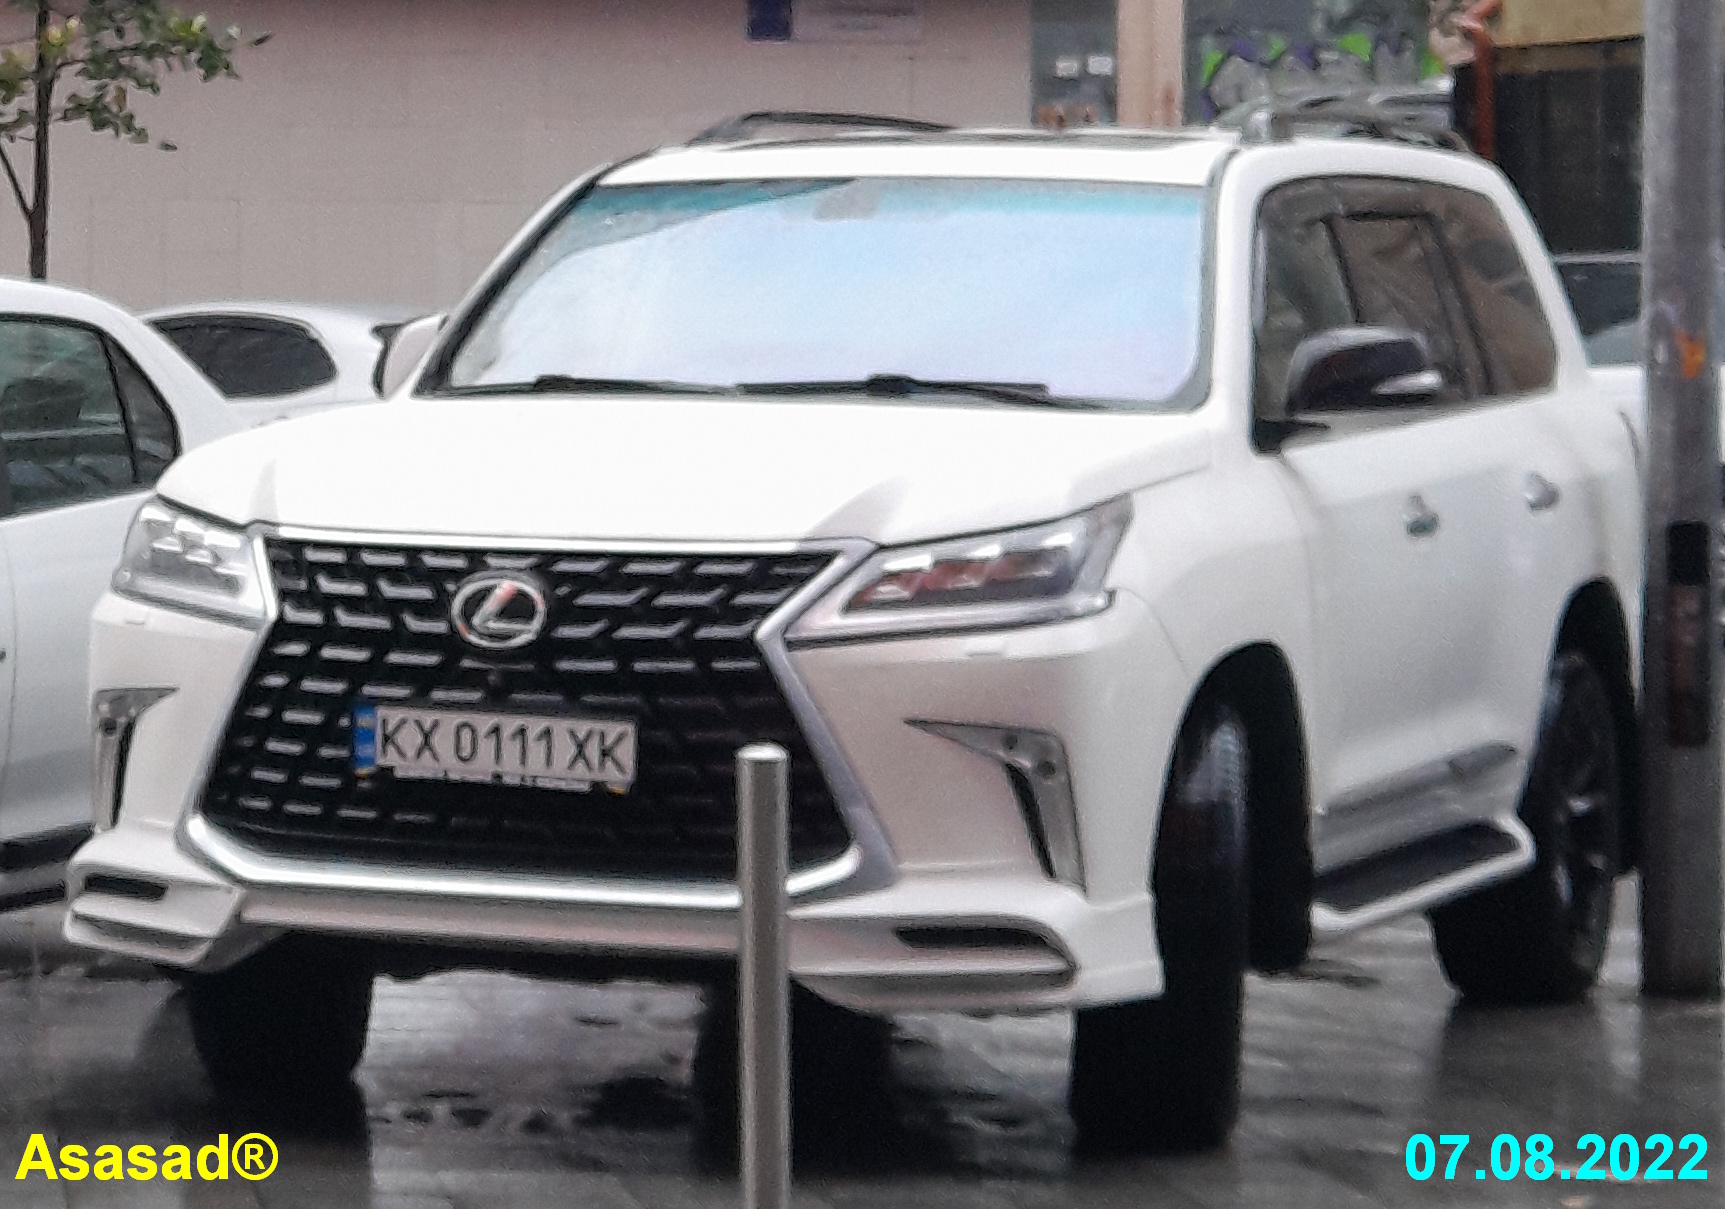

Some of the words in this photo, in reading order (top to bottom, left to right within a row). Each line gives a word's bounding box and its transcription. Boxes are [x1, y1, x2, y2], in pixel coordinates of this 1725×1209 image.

[381, 717, 440, 763] KX
[453, 721, 554, 769] 0111
[566, 728, 628, 775] XK
